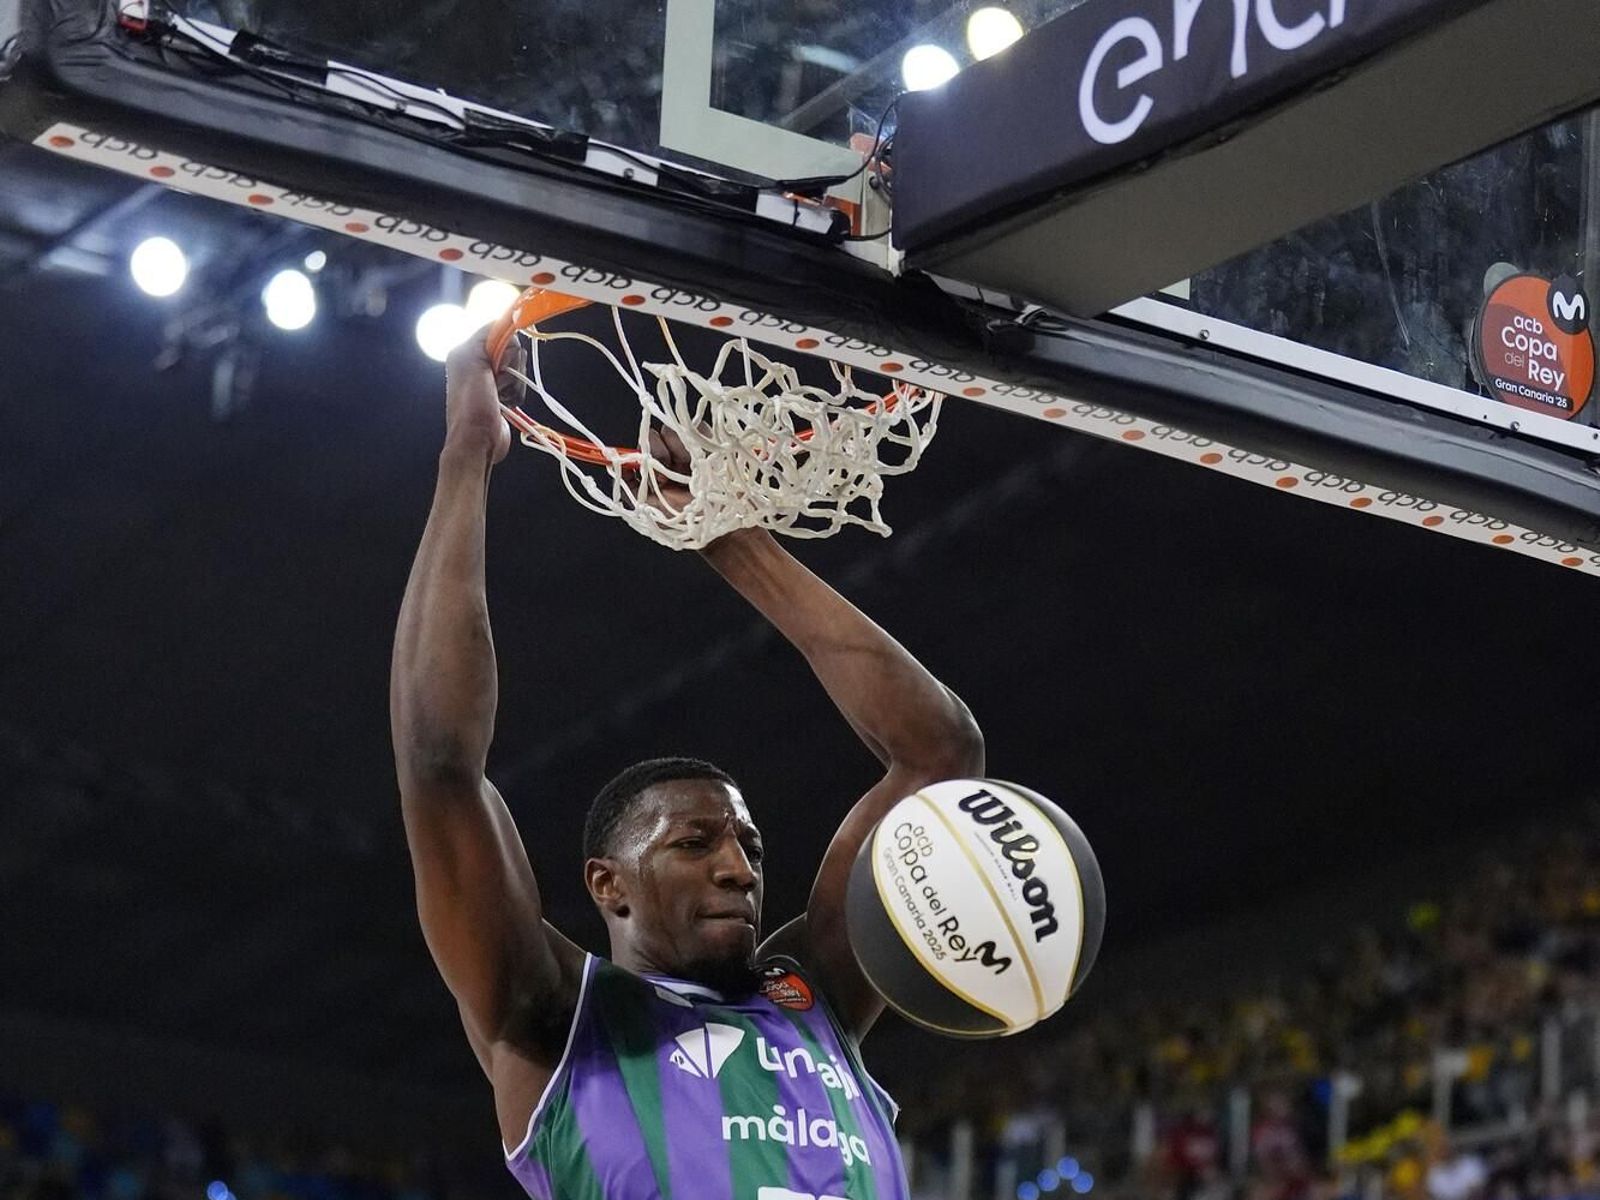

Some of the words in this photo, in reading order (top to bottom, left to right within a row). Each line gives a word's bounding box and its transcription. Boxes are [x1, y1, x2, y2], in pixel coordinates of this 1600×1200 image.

[1501, 326, 1558, 361] Copa
[1513, 315, 1543, 334] acb
[1504, 350, 1525, 368] del
[1528, 359, 1566, 391] Rey
[1494, 378, 1518, 393] Gran
[1518, 385, 1554, 405] Canaria
[912, 825, 934, 857] acb
[958, 788, 1059, 943] Wilson
[894, 822, 928, 885] Copa
[922, 883, 947, 917] del
[937, 915, 978, 963] Rey
[894, 875, 925, 930] Canaria
[922, 929, 948, 961] 2025
[721, 1105, 872, 1166] málaga
